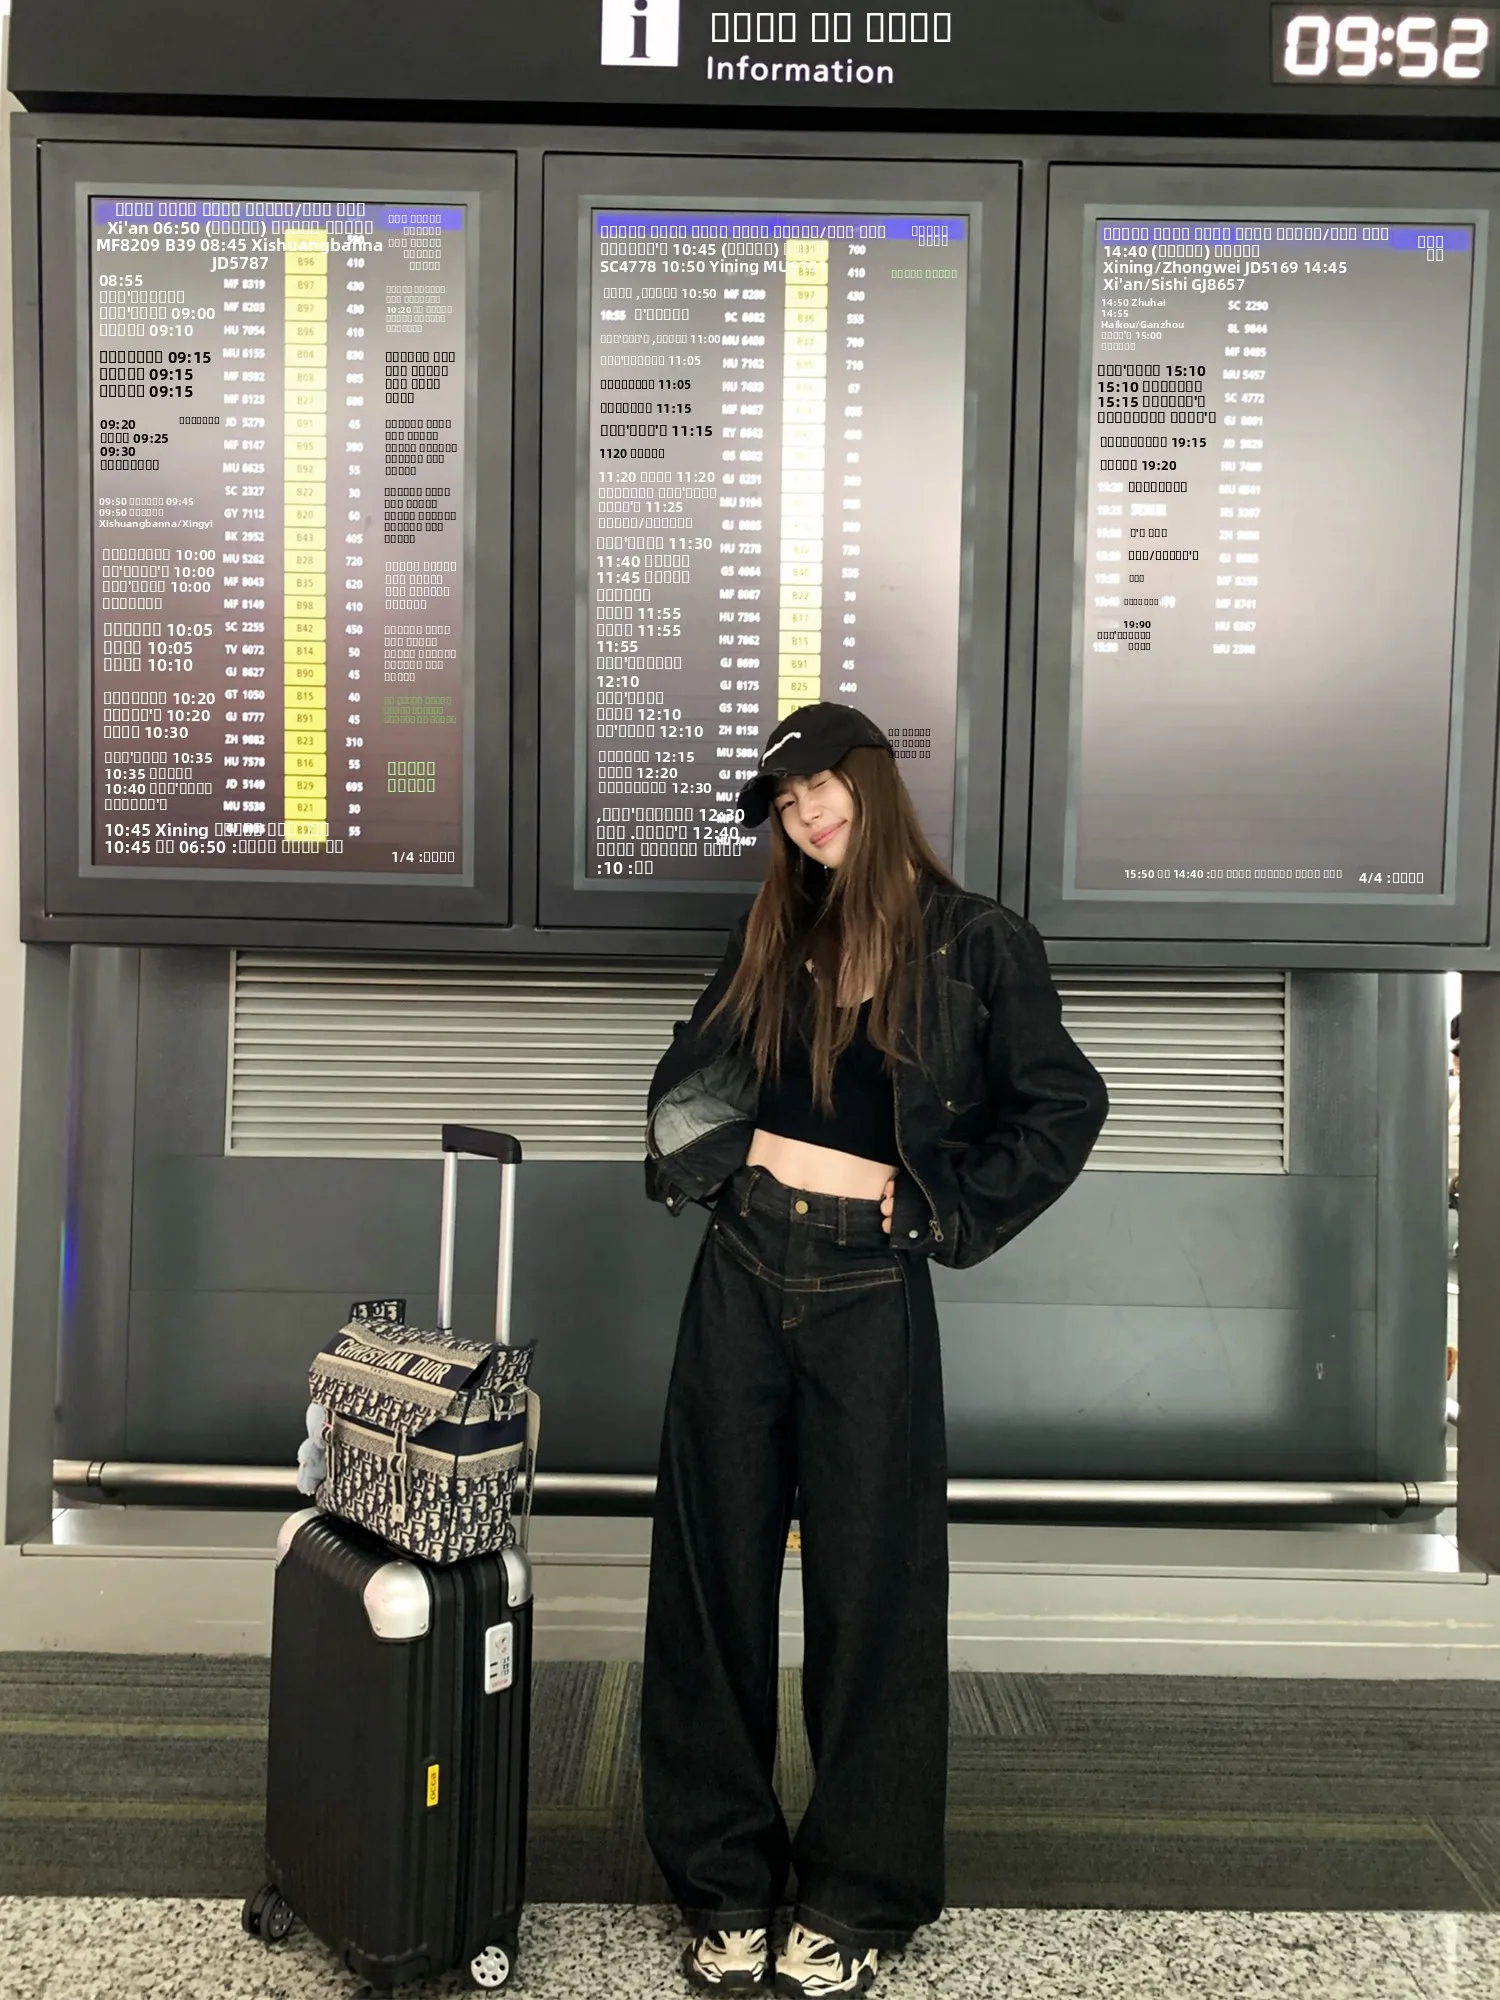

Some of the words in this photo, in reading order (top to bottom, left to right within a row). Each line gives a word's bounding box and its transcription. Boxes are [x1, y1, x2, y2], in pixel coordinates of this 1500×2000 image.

[1284, 14, 1488, 79] 09:52
[708, 55, 893, 83] Information
[297, 578, 313, 587] B35
[346, 602, 363, 611] 410
[297, 624, 313, 632] B42
[346, 625, 363, 634] 450
[297, 647, 313, 655] B14
[349, 647, 360, 657] 50
[297, 669, 313, 678] B90
[348, 670, 360, 679] 45
[297, 692, 313, 700] B15
[348, 693, 360, 702] 40
[297, 714, 312, 722] B91
[348, 715, 360, 724] 45
[297, 736, 313, 745] B23
[346, 737, 363, 747] 310
[717, 748, 733, 757] MU
[297, 759, 313, 767] B16
[349, 759, 360, 769] 55
[297, 781, 314, 790] B29
[297, 803, 312, 812] B21
[349, 804, 360, 814] 30
[349, 826, 360, 836] 55
[334, 1339, 412, 1373] CHRISTIAN
[408, 1361, 452, 1384] DIOR
